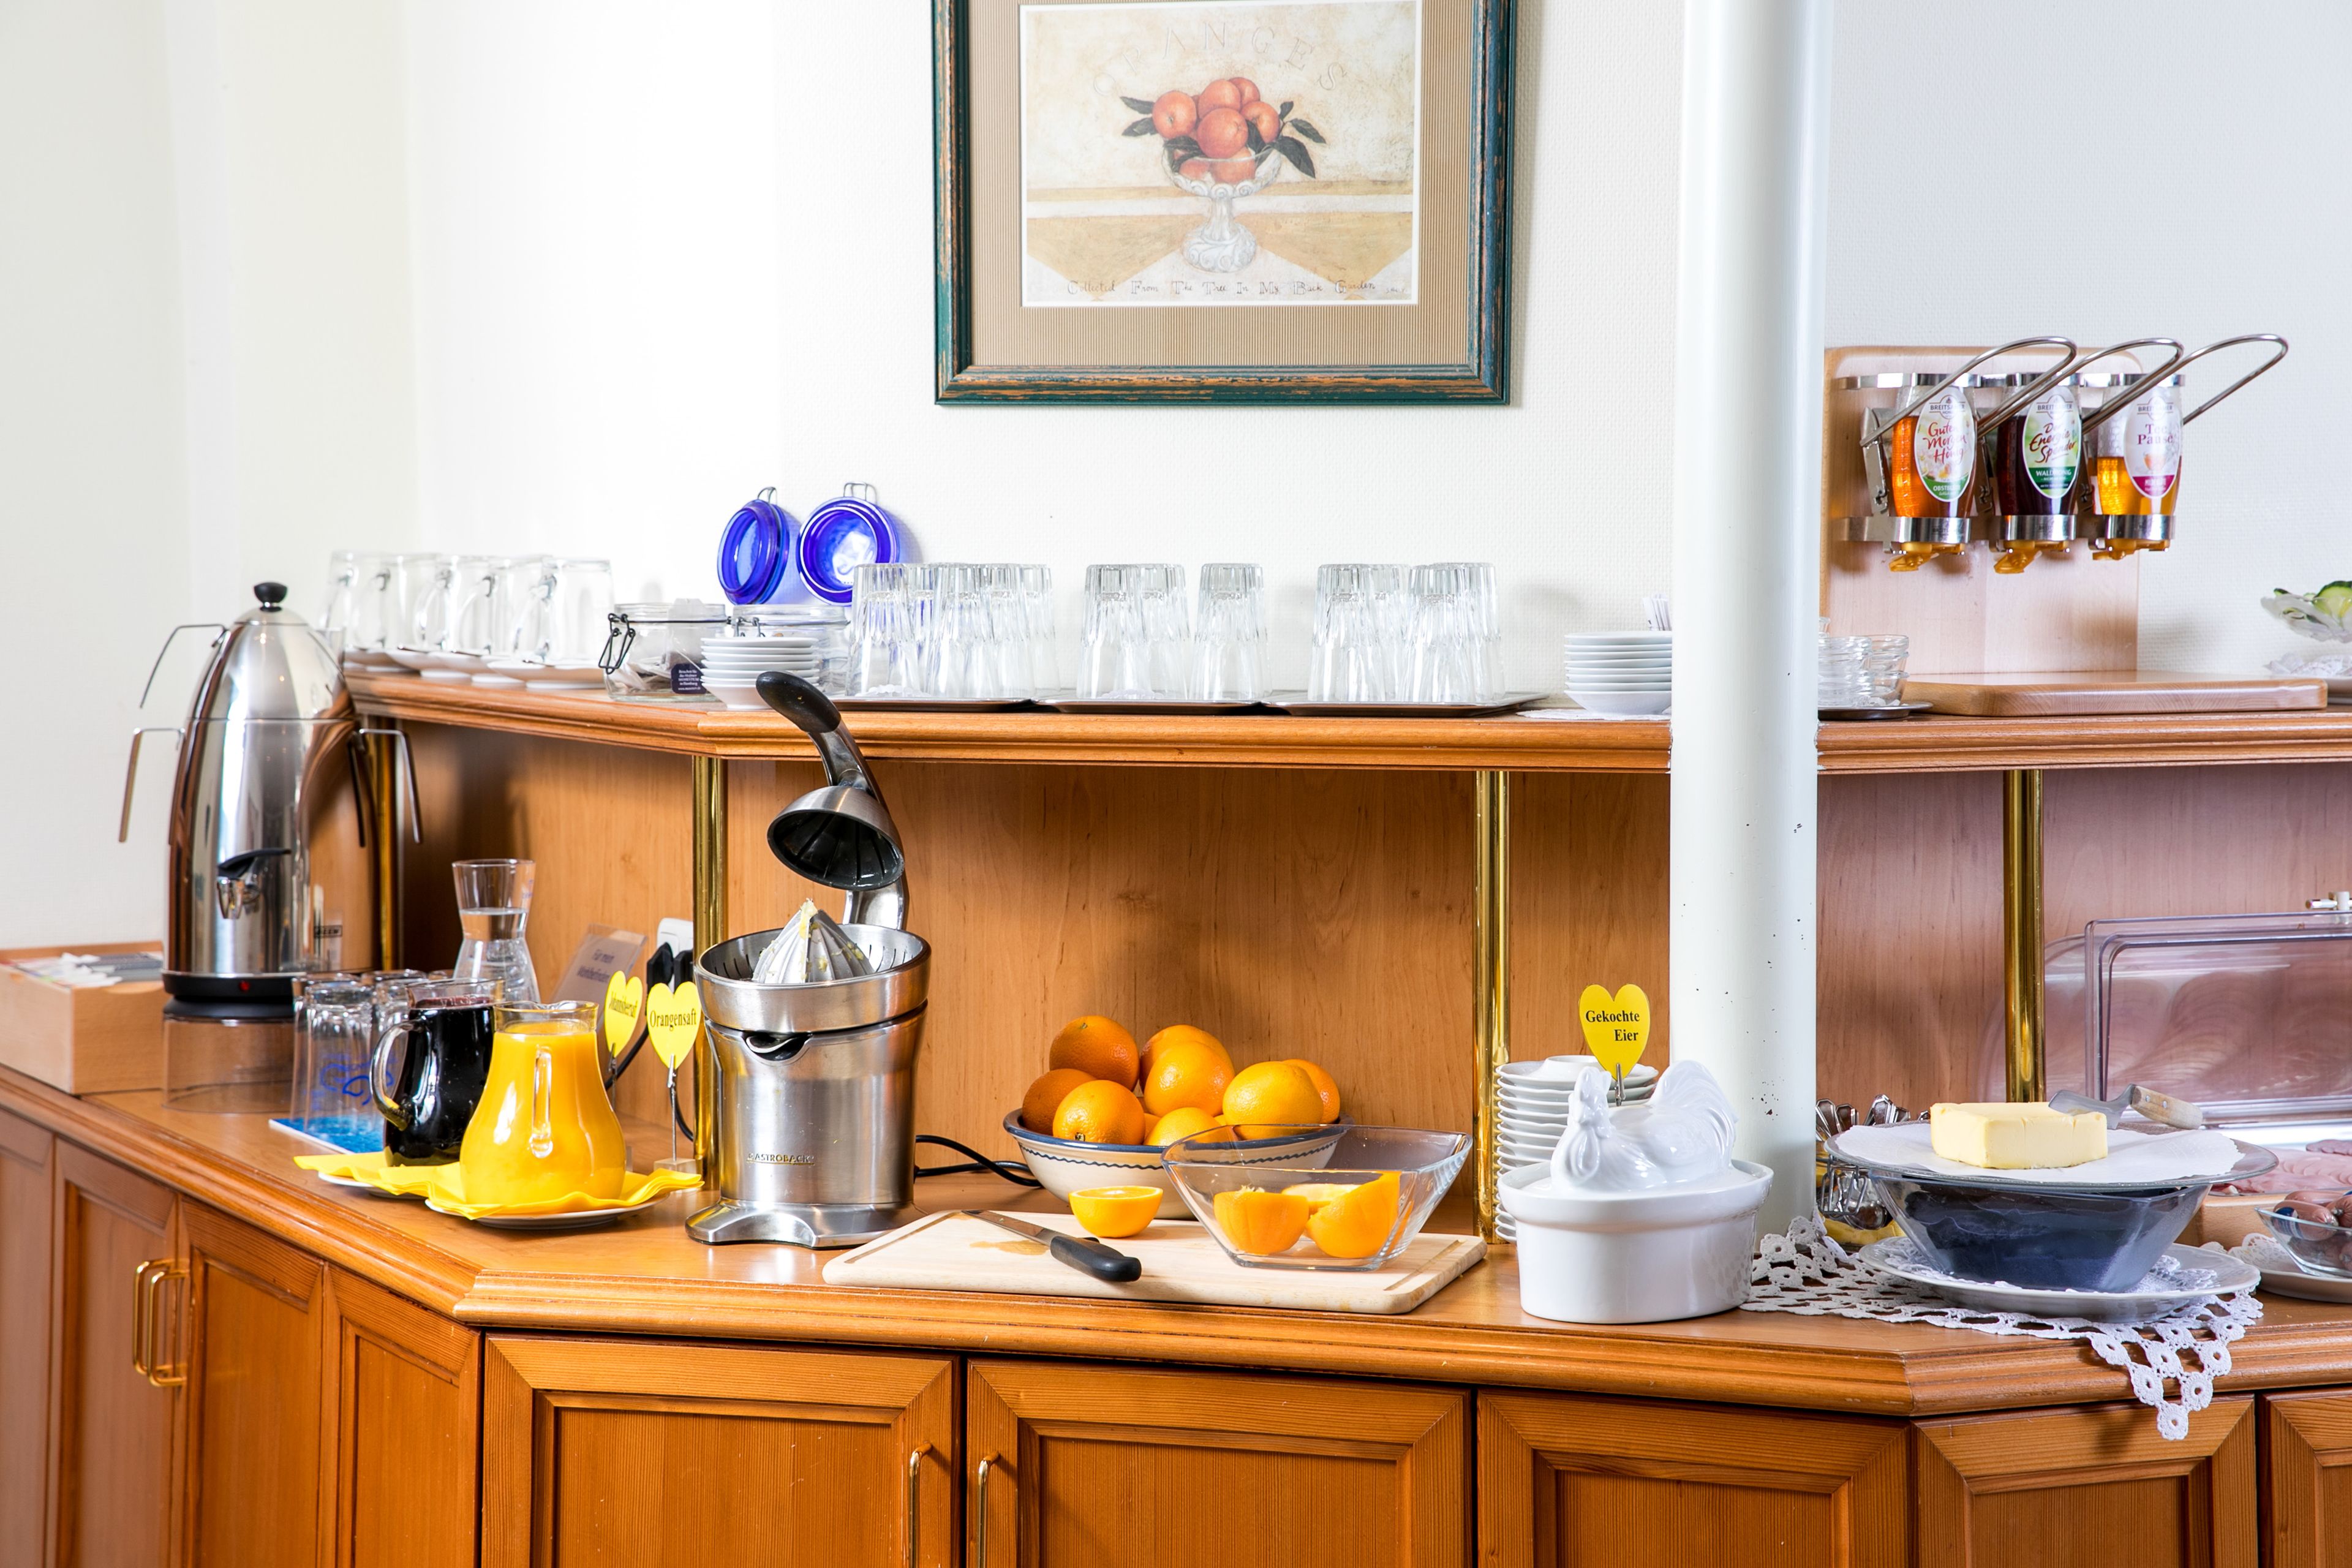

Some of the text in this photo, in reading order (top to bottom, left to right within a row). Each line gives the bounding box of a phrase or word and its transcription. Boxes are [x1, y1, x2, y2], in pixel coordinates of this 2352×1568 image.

[1093, 22, 1348, 97] ORANGES
[1067, 280, 1116, 295] Collected
[1131, 281, 1159, 295] From
[1171, 281, 1193, 295] The
[1202, 281, 1227, 295] Tree
[1236, 282, 1248, 294] In
[1259, 281, 1279, 295] My
[1293, 281, 1323, 295] Back
[1335, 280, 1376, 294] Garden
[1928, 420, 1957, 437] Gute
[2145, 423, 2167, 434] Tee
[1922, 434, 1967, 451] Morgn
[2137, 434, 2174, 445] Pause
[649, 1008, 697, 1032] Orangensaft
[1585, 1010, 1640, 1023] Gekochte
[1614, 1029, 1639, 1041] Eier
